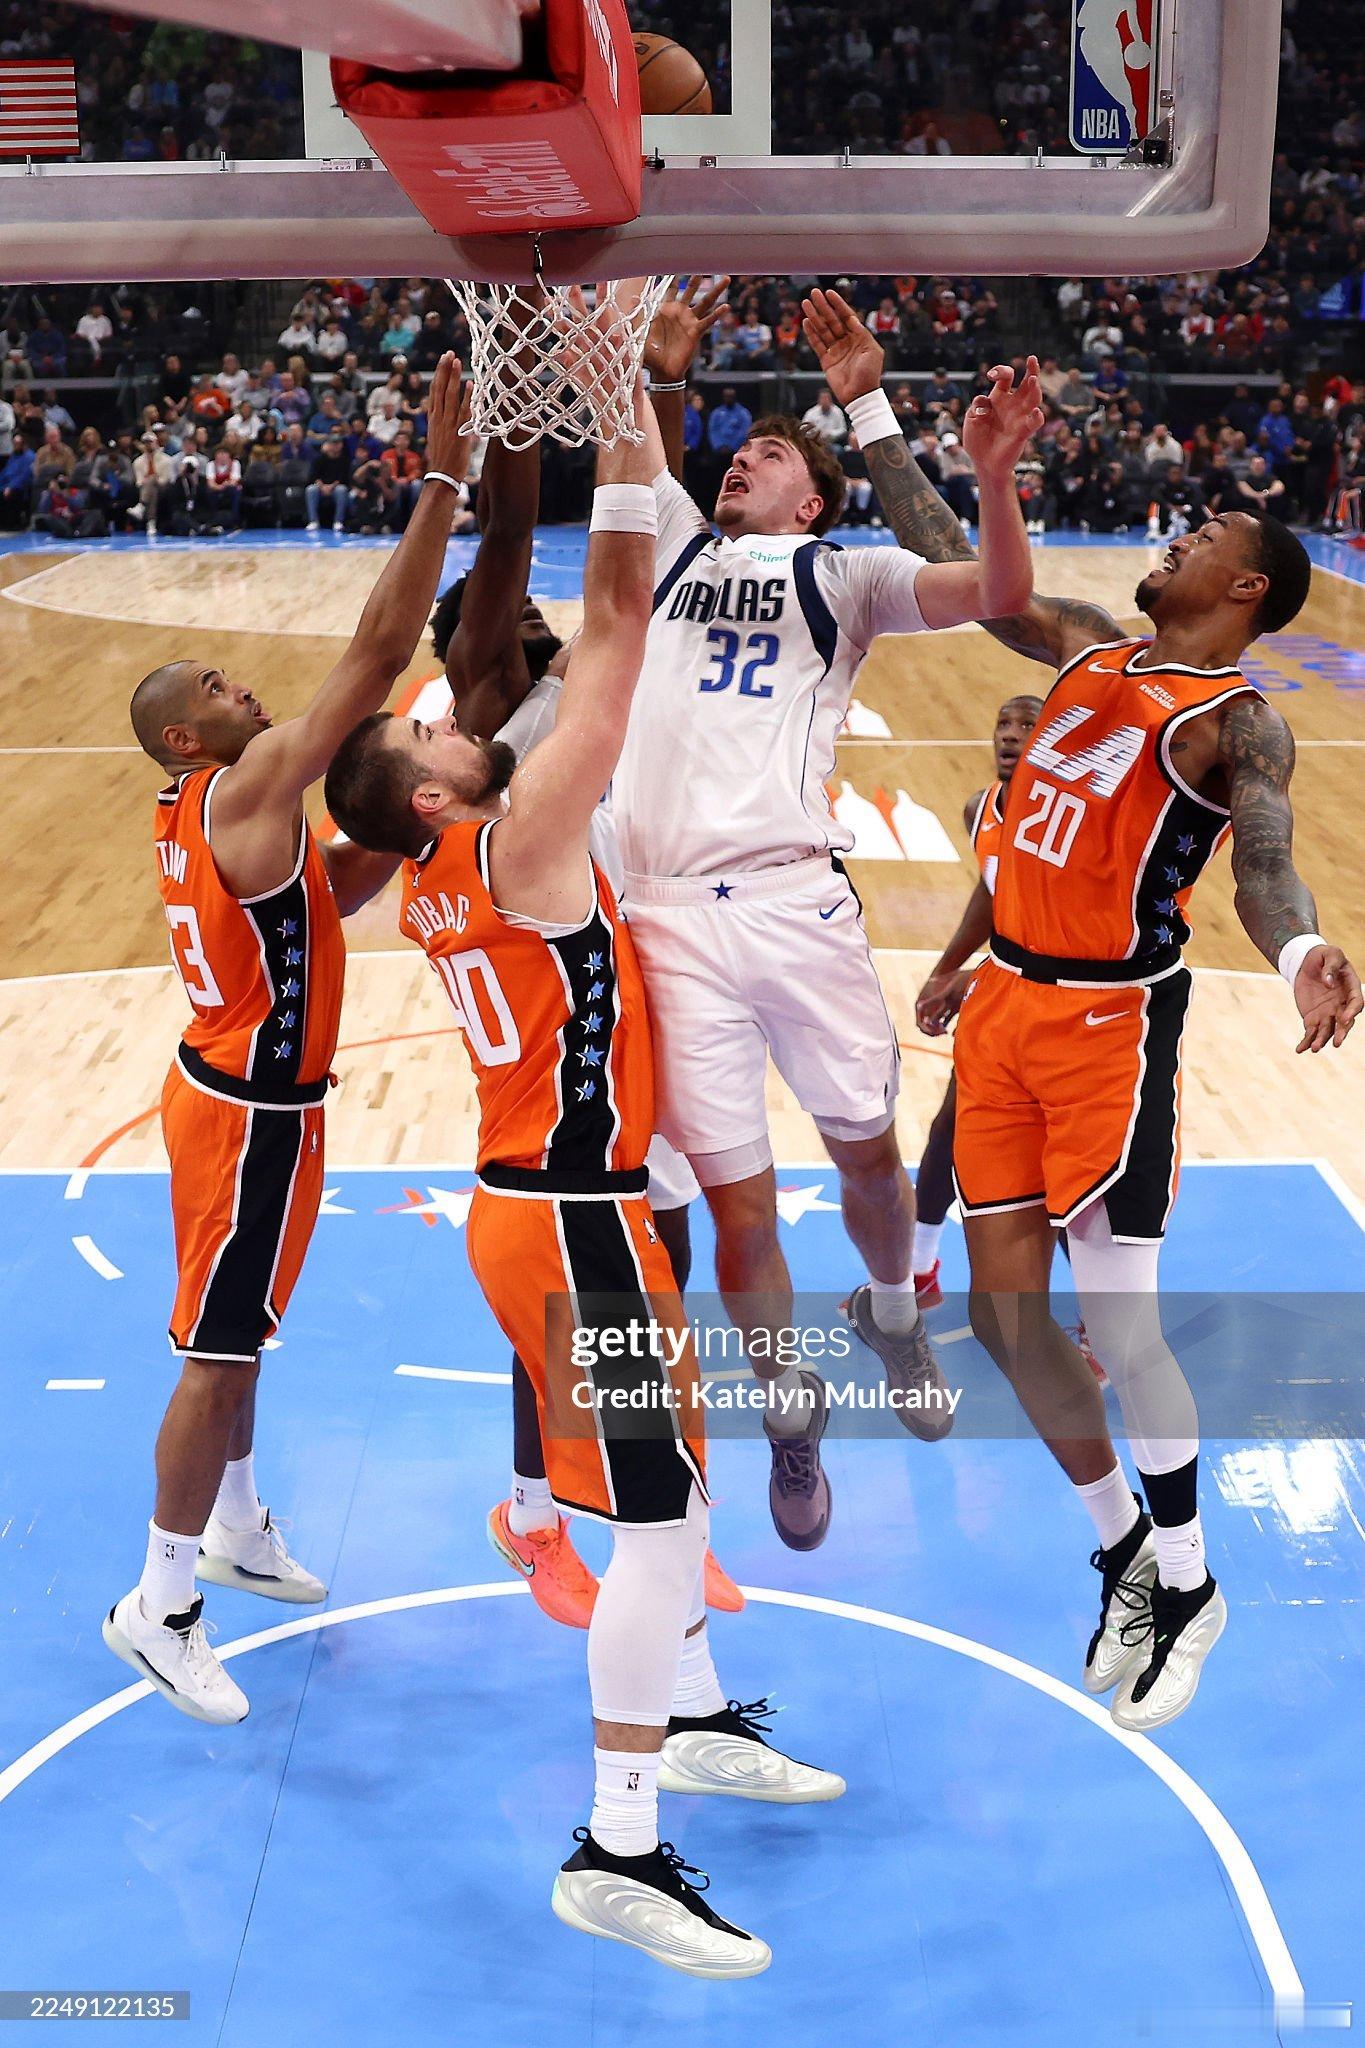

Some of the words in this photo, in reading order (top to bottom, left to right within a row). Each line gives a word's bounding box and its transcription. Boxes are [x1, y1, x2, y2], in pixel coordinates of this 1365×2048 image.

[1082, 108, 1120, 139] NBA
[698, 627, 780, 698] 32
[1138, 683, 1176, 711] RWANDA
[1153, 684, 1176, 703] VISIT
[1024, 704, 1147, 799] LA
[1013, 779, 1087, 869] 20
